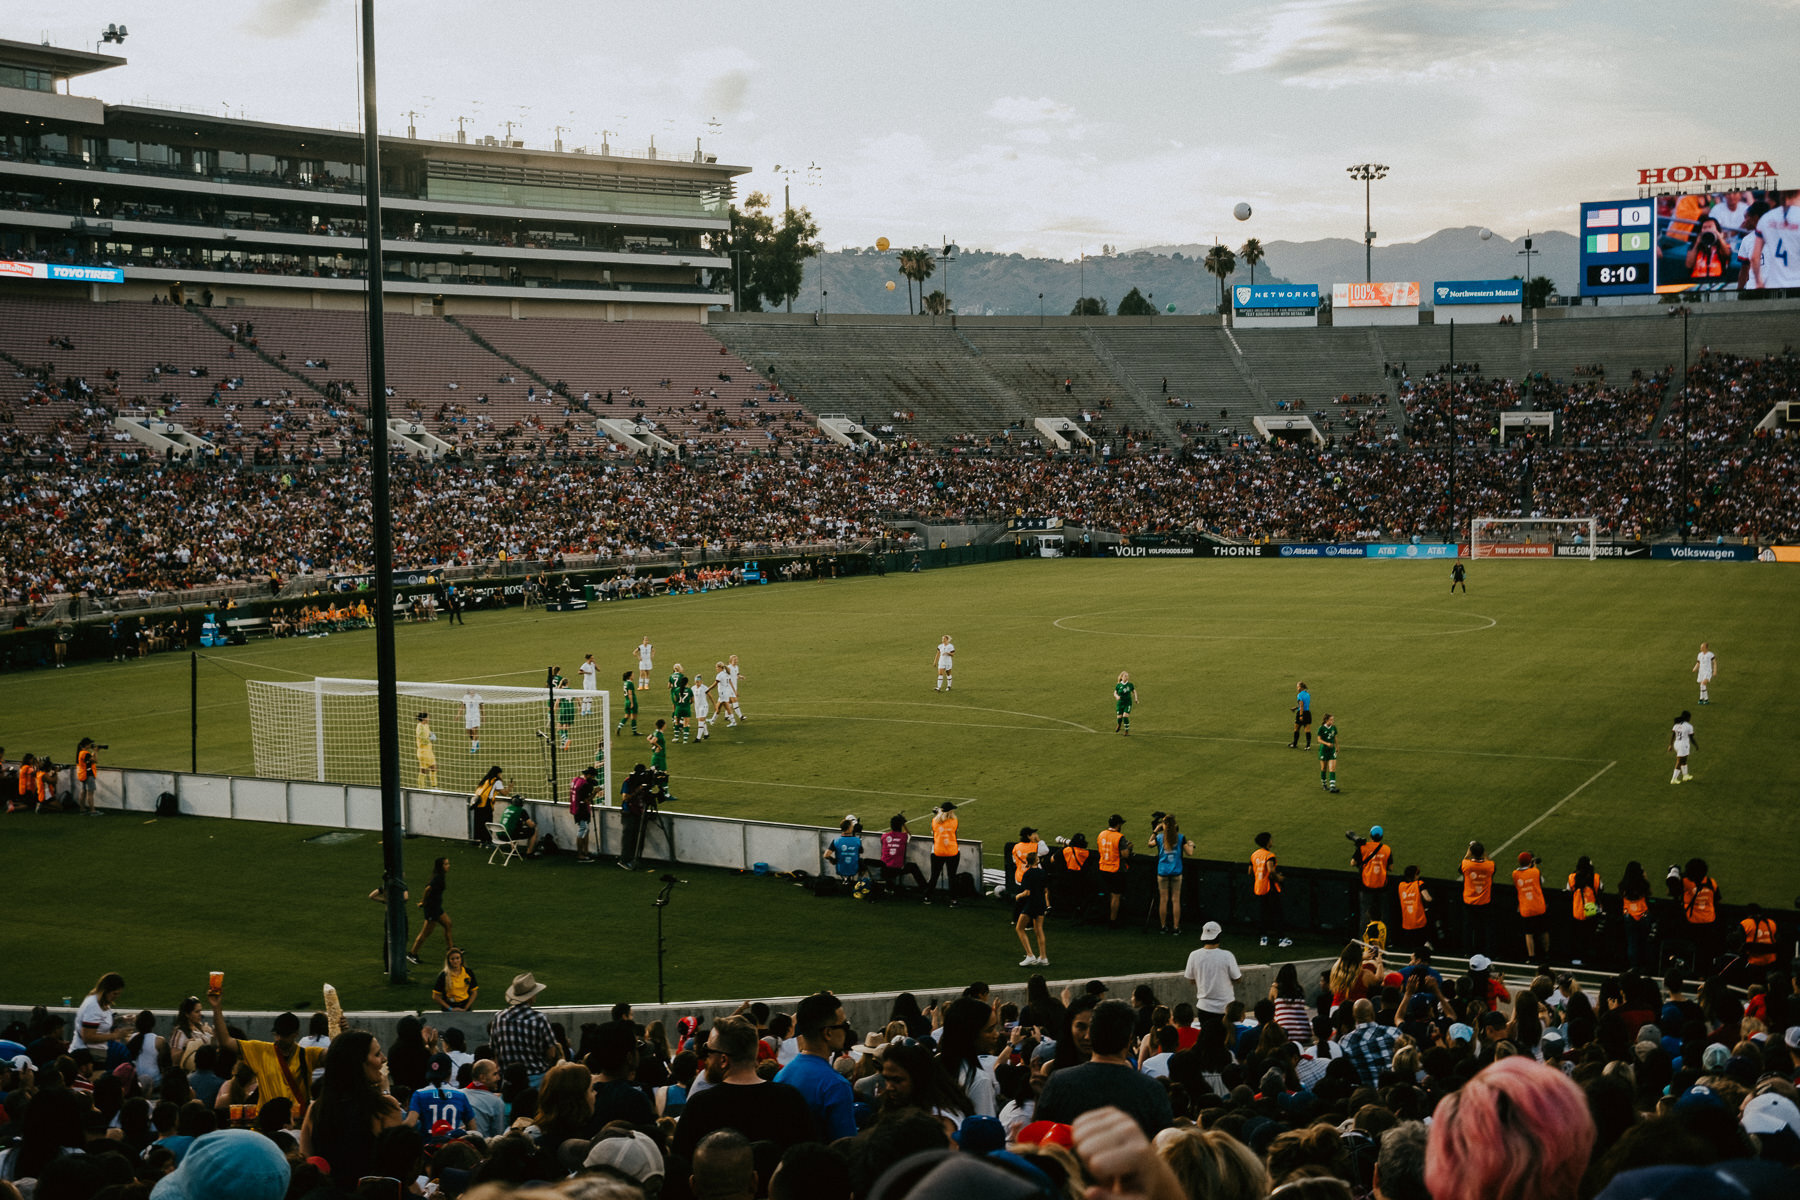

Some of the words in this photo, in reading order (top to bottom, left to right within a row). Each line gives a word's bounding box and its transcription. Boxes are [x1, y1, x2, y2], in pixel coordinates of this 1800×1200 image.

[1637, 161, 1779, 185] HONDA
[1632, 210, 1640, 223] 0
[1631, 235, 1641, 248] 0
[1775, 237, 1788, 267] 4
[54, 267, 84, 278] TOYO
[85, 269, 115, 280] TIRES
[1600, 266, 1636, 283] 8:10
[1350, 284, 1375, 300] 100%
[1449, 290, 1494, 298] Northwestern
[1495, 288, 1519, 297] Mutual
[1115, 546, 1146, 556] VOLPI
[1212, 546, 1261, 556] THORNE
[1293, 547, 1318, 555] Allstate
[1337, 547, 1363, 555] Allstate
[1378, 547, 1397, 555] AT&T
[1427, 547, 1447, 555] AT&T
[1670, 547, 1735, 559] Volkswagen
[429, 1104, 457, 1133] 10
